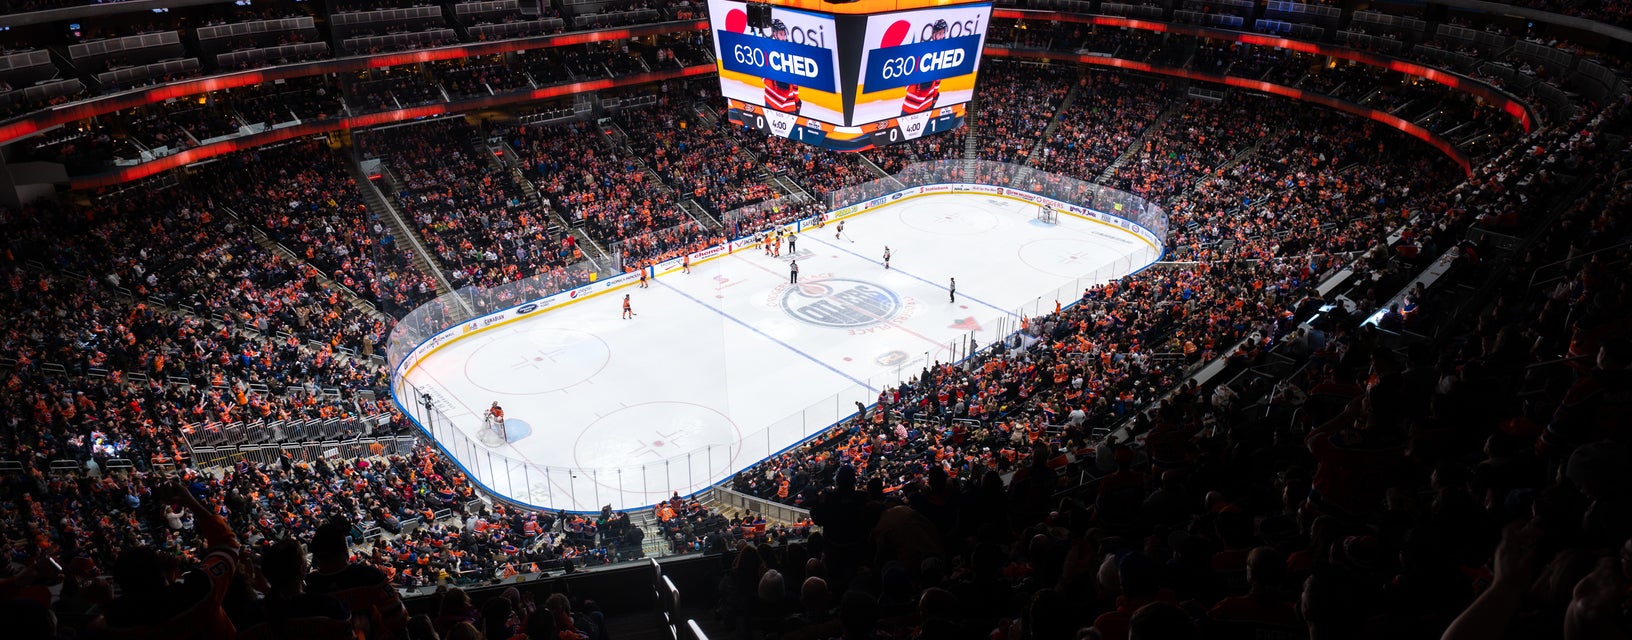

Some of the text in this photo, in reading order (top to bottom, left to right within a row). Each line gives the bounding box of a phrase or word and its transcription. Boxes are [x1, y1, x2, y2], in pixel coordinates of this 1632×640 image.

[734, 44, 818, 78] 630 CHED
[883, 48, 965, 79] 630 CHED
[756, 116, 764, 129] 0
[772, 119, 787, 130] 4:00
[906, 122, 921, 133] 4:00
[930, 119, 936, 132] 1
[797, 127, 803, 140] 1
[889, 128, 898, 142] 0
[1042, 199, 1064, 209] ROGERS
[694, 246, 725, 259] chemco
[484, 314, 505, 325] CANADIAN
